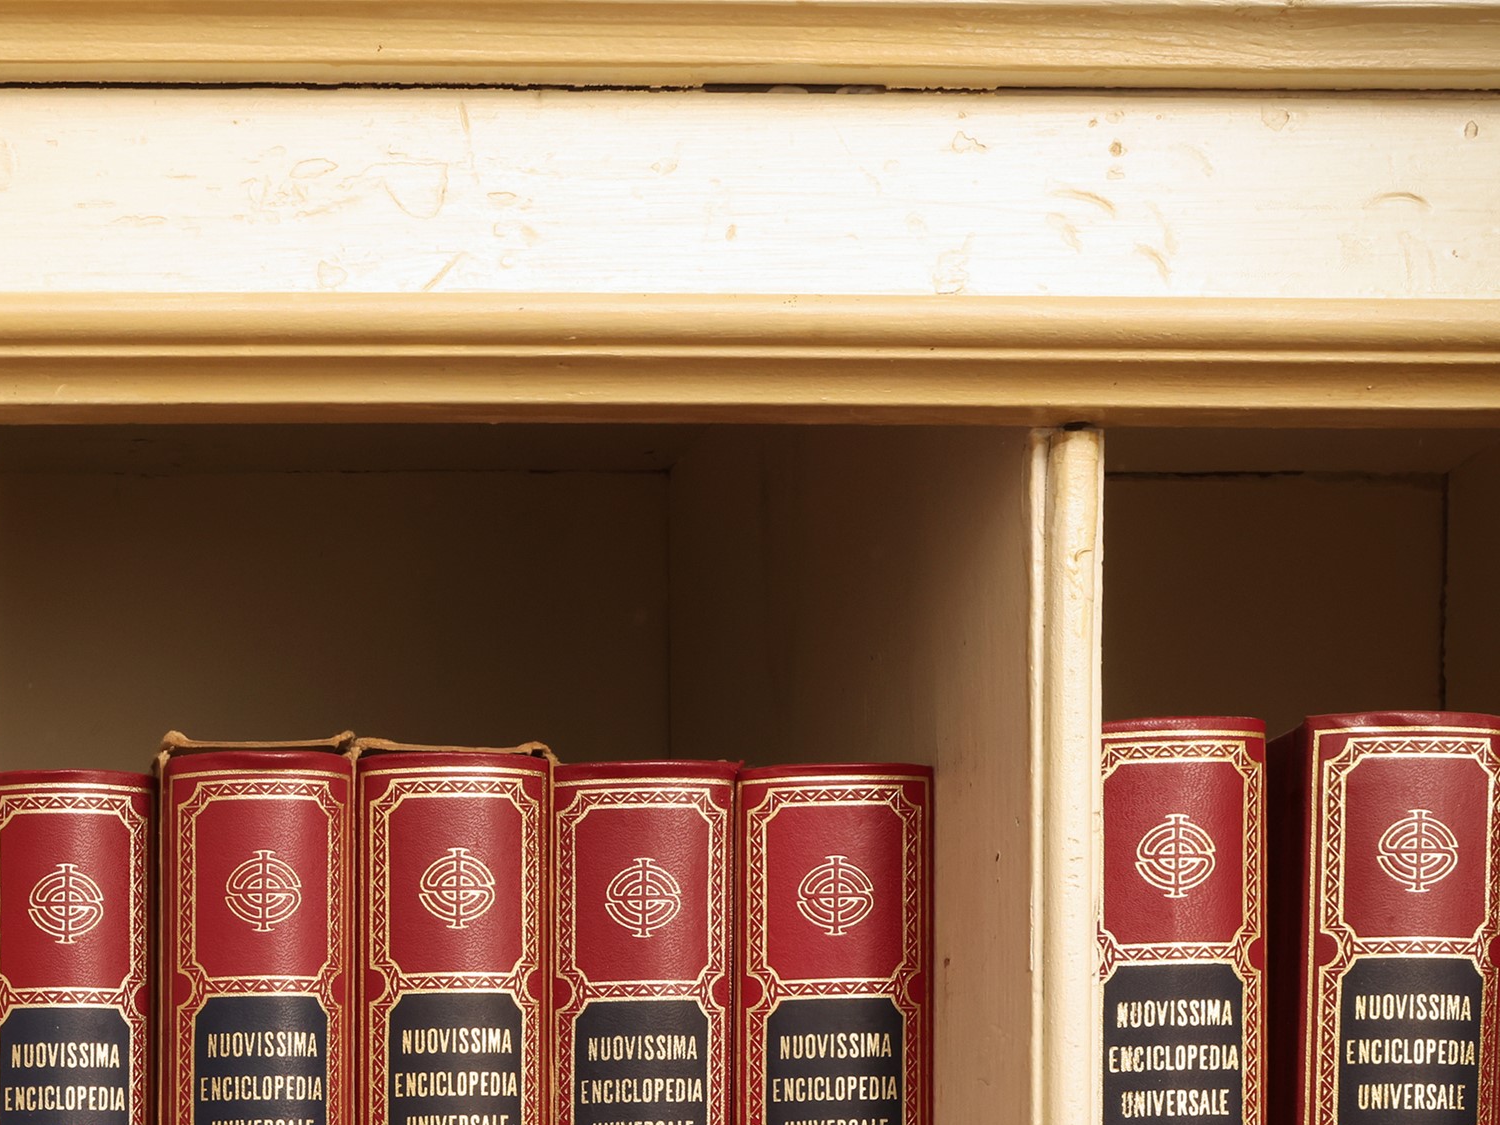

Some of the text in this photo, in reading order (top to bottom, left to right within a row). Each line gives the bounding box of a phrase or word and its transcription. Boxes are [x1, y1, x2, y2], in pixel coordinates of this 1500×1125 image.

[1117, 999, 1232, 1028] NUOVISSIMA
[1356, 994, 1471, 1020] NUOVISSIMA
[208, 1031, 317, 1057] NUOVISSIMA
[403, 1028, 512, 1054] NUOVISSIMA
[589, 1035, 697, 1061] NUOVISSIMA
[781, 1033, 891, 1059] NUOVISSIMA
[1347, 1039, 1474, 1065] ENCICLOPEDIA
[12, 1042, 119, 1068] NUOVISSIMA
[1109, 1045, 1238, 1073] ENCICLOPEDIA
[201, 1076, 322, 1101] ENCICLOPEDIA
[395, 1071, 517, 1097] ENCICLOPEDIA
[582, 1078, 702, 1103] ENCICLOPEDIA
[773, 1076, 896, 1102] ENCICLOPEDIA
[1359, 1083, 1465, 1110] UNIVERSALE
[5, 1086, 125, 1110] ENCICLOPEDIA
[1122, 1089, 1229, 1118] UNIVERSALE
